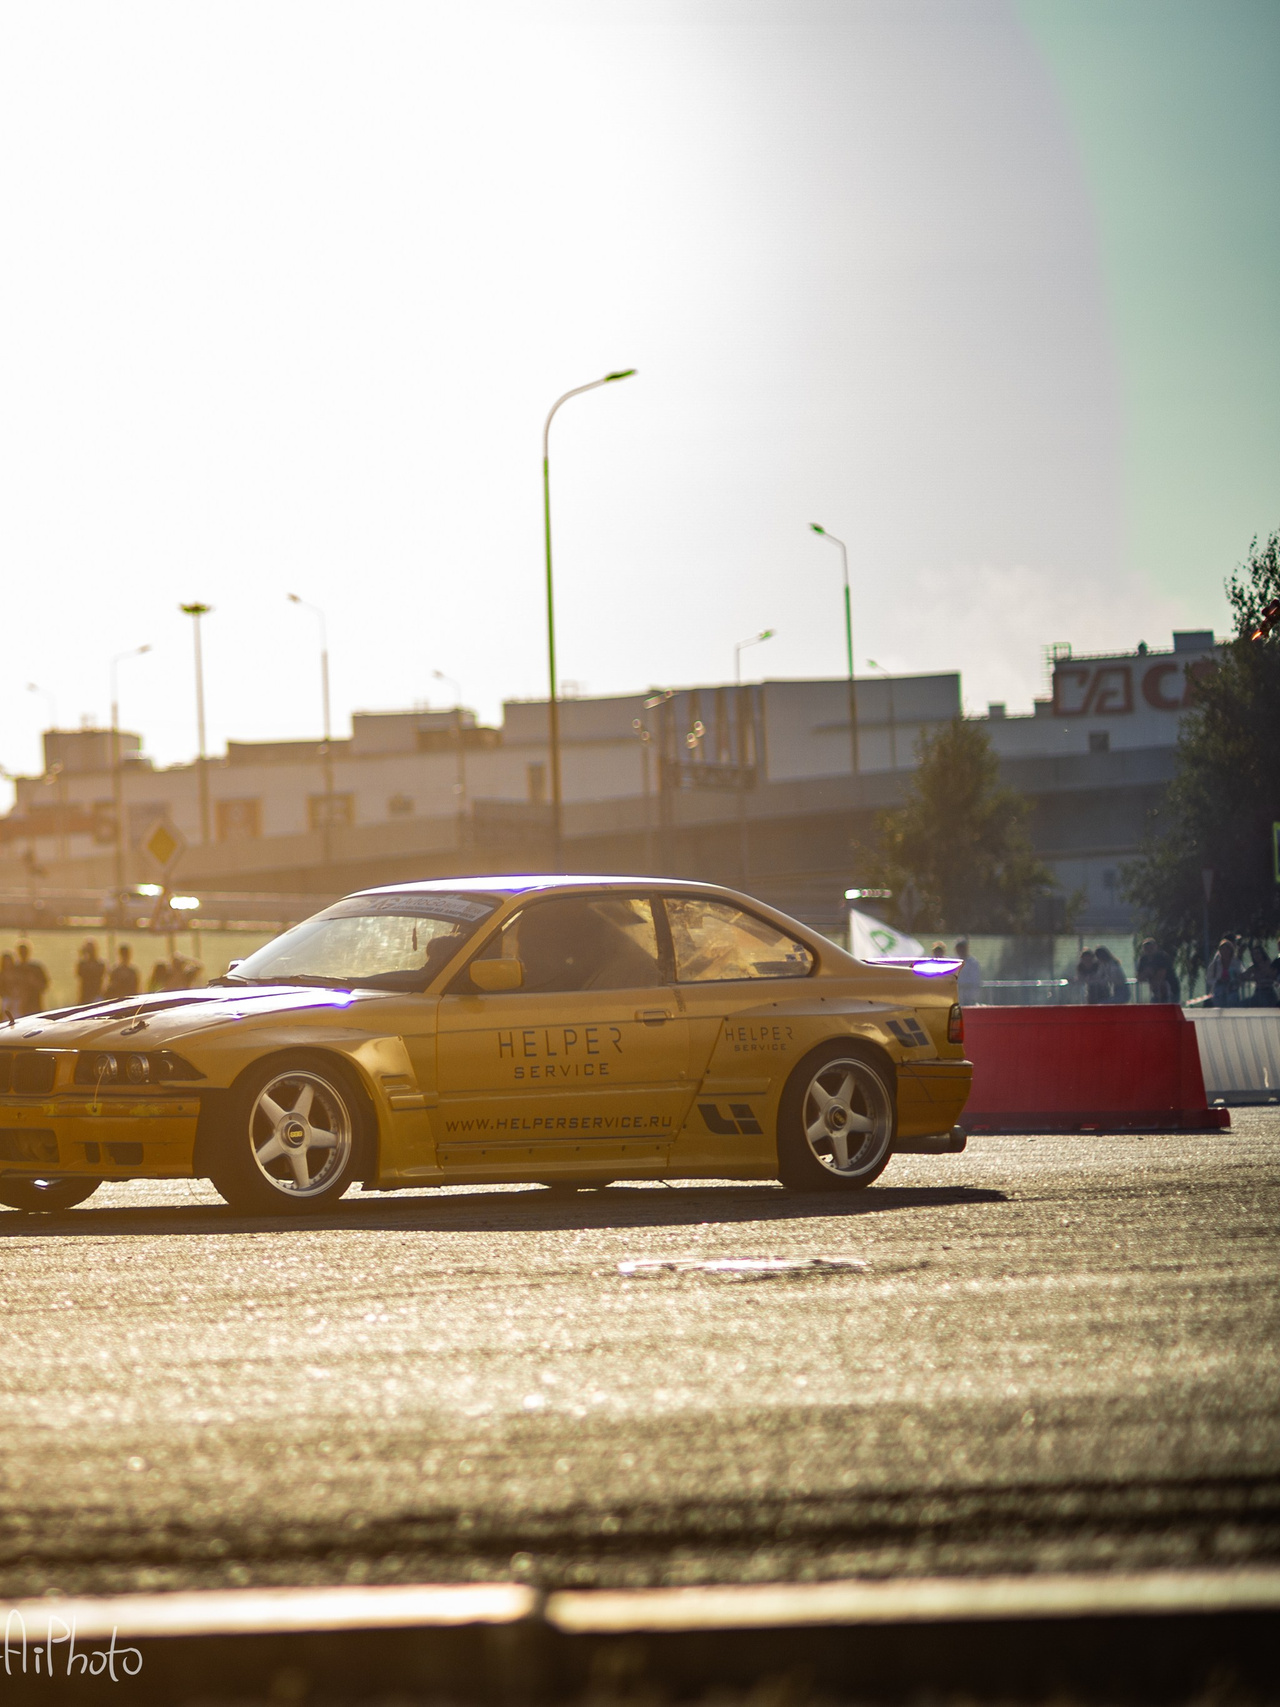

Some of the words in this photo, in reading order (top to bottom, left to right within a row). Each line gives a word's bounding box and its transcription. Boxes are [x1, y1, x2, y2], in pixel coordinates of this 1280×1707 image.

[724, 1026, 793, 1041] HELPER
[497, 1026, 623, 1059] HELPER
[734, 1043, 787, 1052] SERVICE
[513, 1062, 610, 1079] SERVICE
[445, 1115, 673, 1132] WWW.HELPERSERVICE.RU
